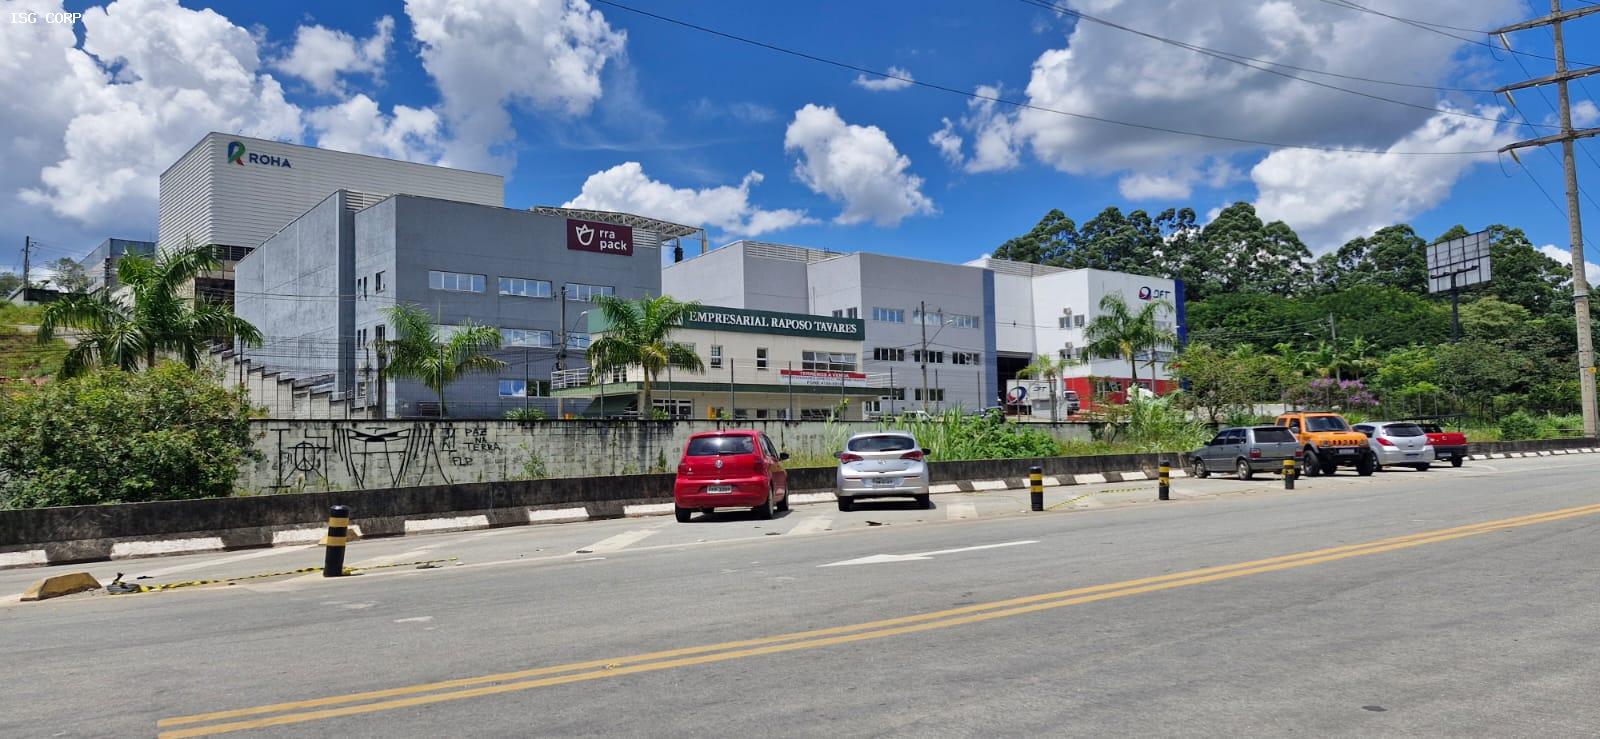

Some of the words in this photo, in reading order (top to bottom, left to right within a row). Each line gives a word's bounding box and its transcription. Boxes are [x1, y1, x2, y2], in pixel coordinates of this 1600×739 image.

[249, 153, 292, 168] ROHA
[600, 229, 615, 239] rra
[600, 240, 627, 251] pack
[689, 311, 769, 327] EMPRESARIAL
[771, 317, 813, 331] RAPOSO
[813, 321, 857, 333] TAVARES
[465, 428, 488, 437] PAZ
[463, 442, 502, 451] TERRA
